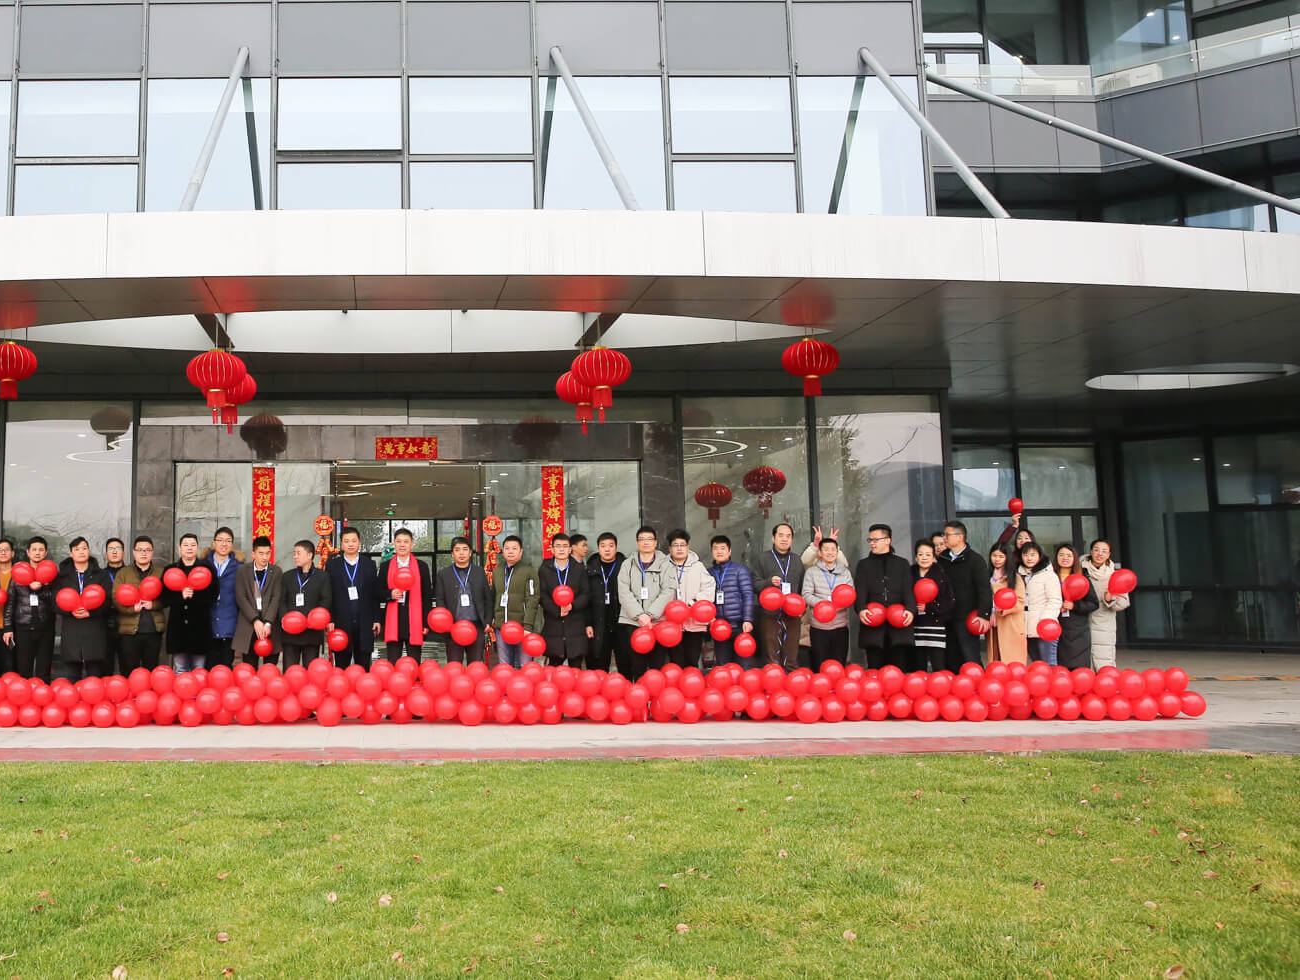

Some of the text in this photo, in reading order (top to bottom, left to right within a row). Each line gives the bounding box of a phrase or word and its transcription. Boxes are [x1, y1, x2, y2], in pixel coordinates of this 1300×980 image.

[384, 441, 431, 455] 萬事如意
[545, 473, 562, 553] 事業輝煌
